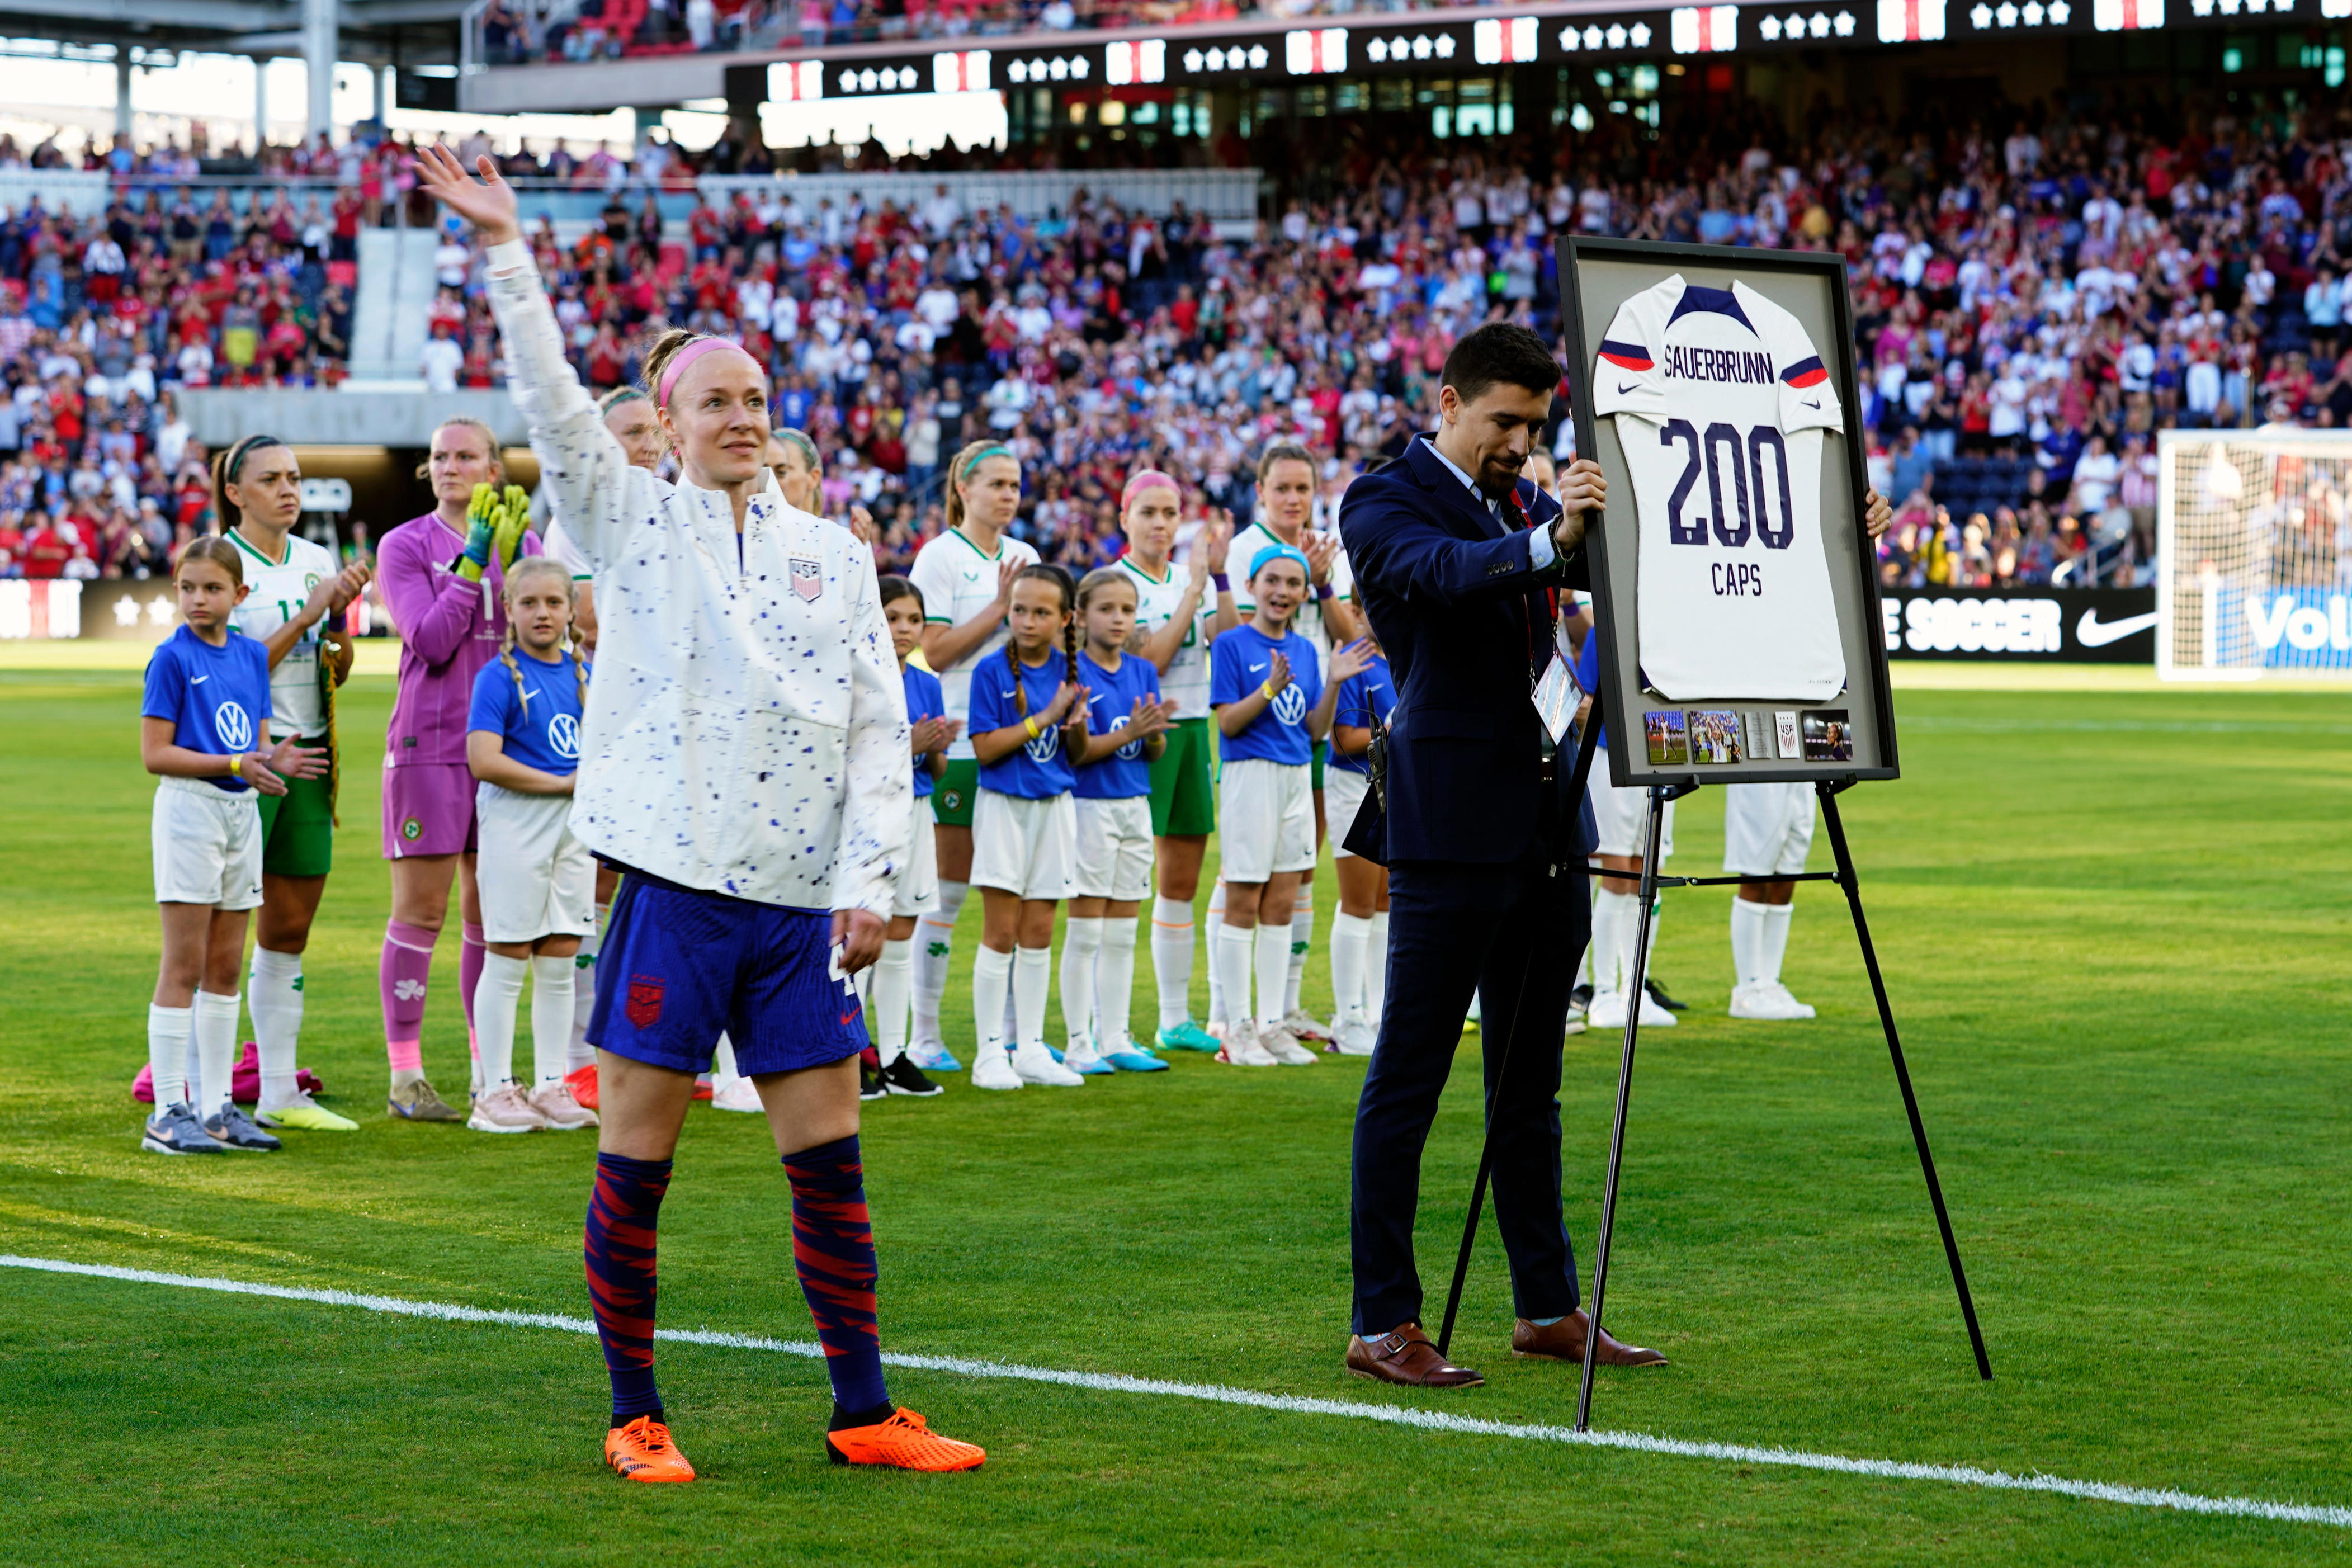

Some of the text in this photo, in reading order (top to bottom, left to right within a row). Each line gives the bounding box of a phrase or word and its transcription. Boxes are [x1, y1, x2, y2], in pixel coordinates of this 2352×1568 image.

[1664, 344, 1775, 384] SAUERBRUNN
[1660, 418, 1794, 550] 200
[479, 577, 494, 621] 1
[1712, 563, 1762, 596] CAPS
[1905, 597, 2062, 652] SOCCER
[215, 701, 251, 750] VW
[1780, 724, 1793, 736] USA
